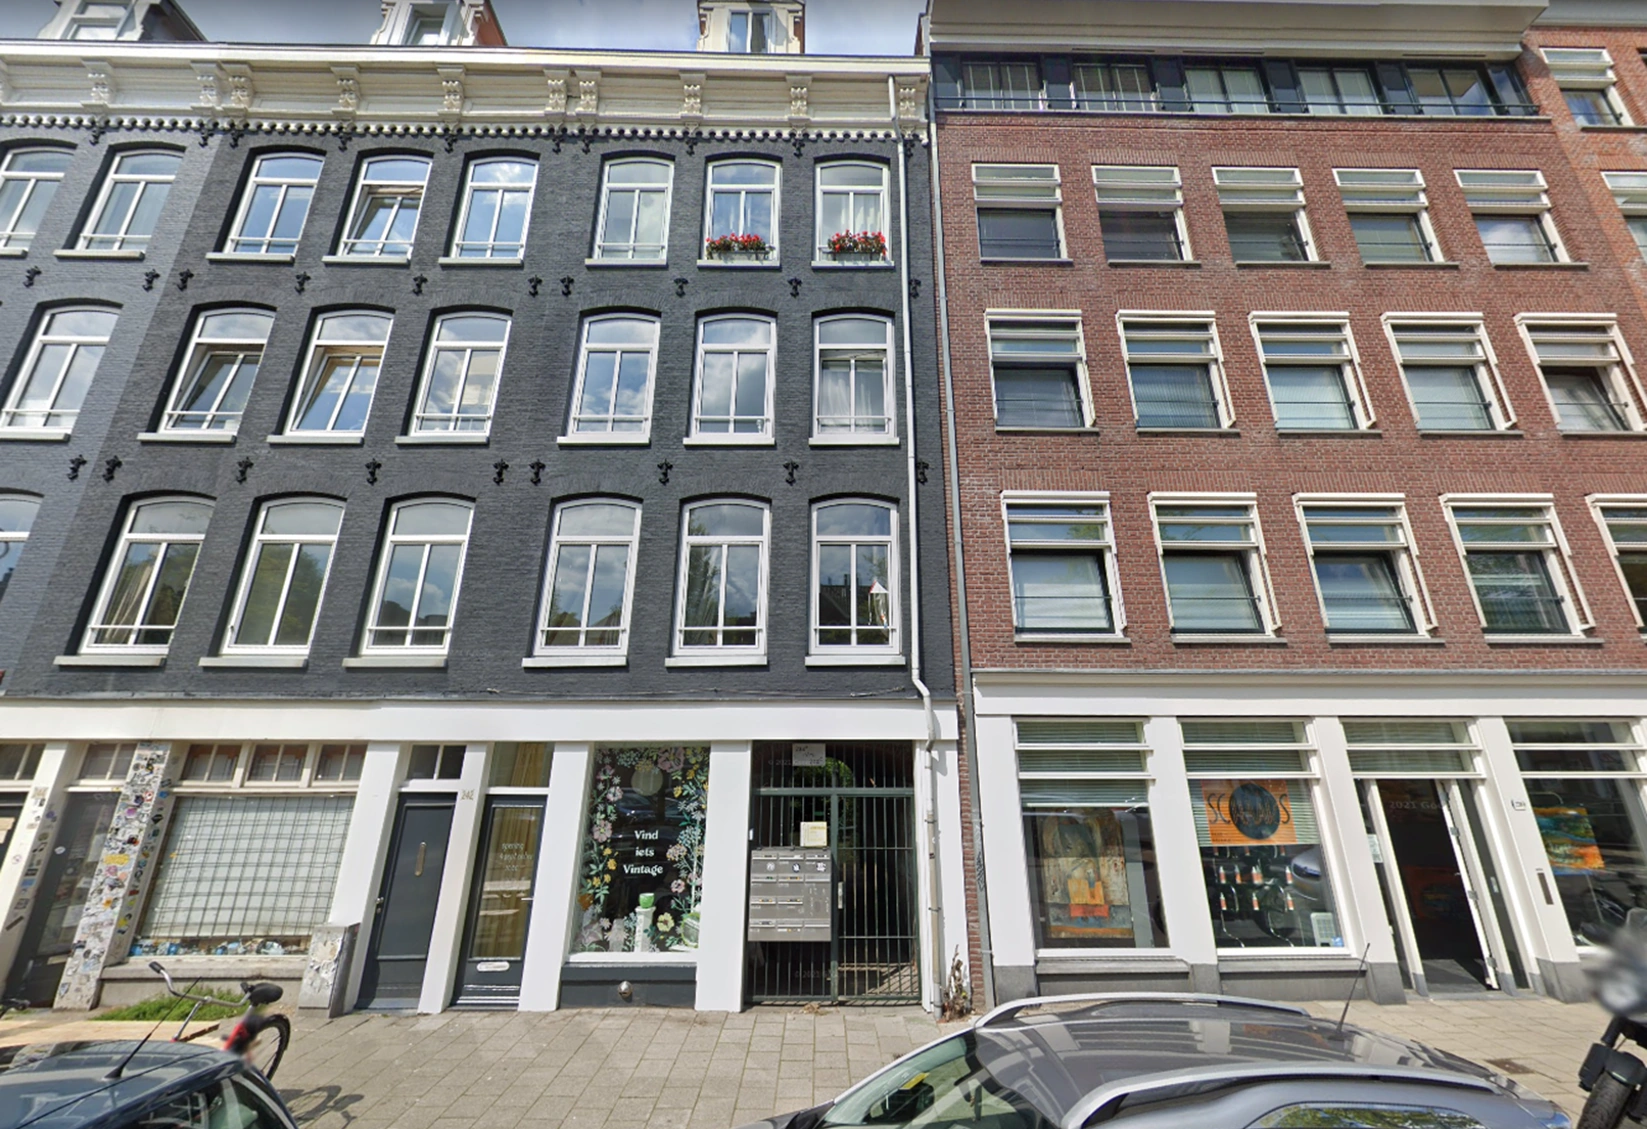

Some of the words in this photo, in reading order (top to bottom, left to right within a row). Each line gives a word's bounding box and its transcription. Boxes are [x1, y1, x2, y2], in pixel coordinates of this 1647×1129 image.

[634, 829, 659, 840] Vind
[635, 846, 655, 857] iets
[623, 863, 664, 877] Vintage
